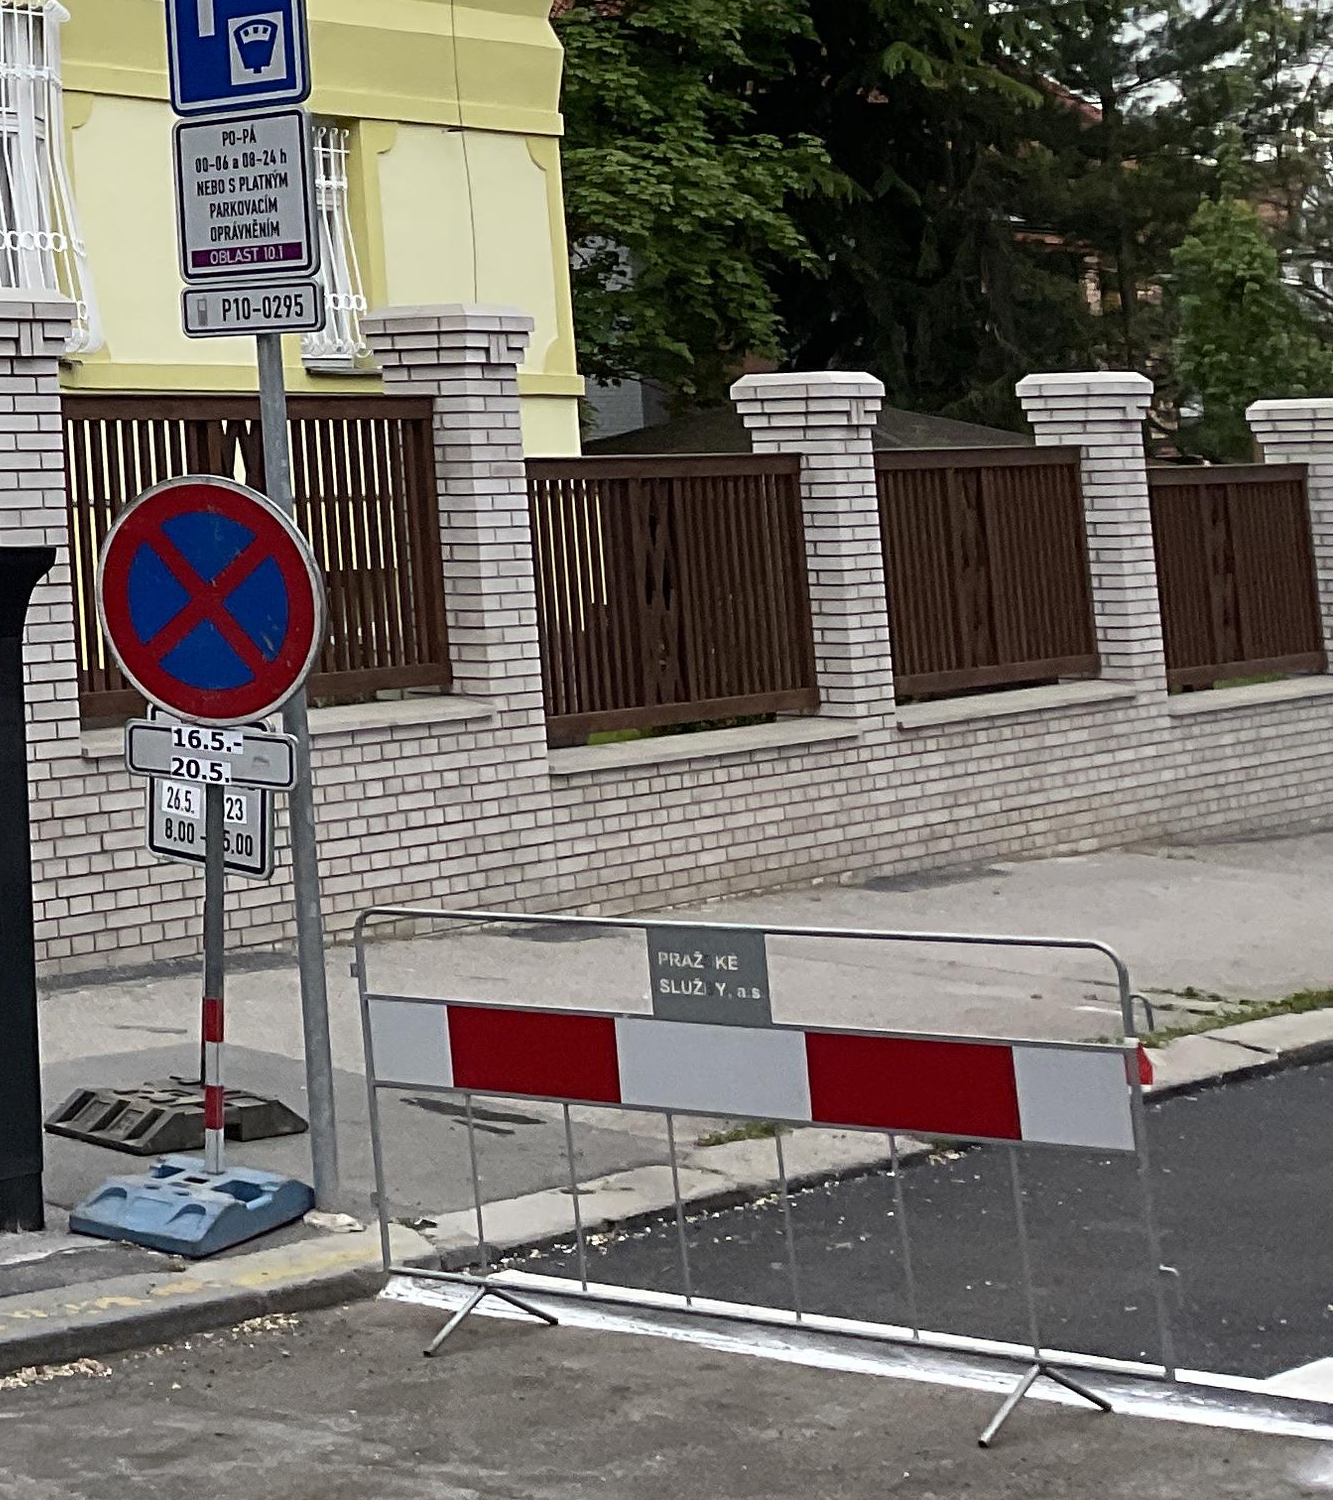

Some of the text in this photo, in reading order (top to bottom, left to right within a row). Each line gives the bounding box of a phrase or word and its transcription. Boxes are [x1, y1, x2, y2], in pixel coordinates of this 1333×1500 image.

[221, 124, 257, 147] PO-PÁ
[195, 148, 287, 173] 00-06 a 08-24 h
[196, 169, 288, 196] NEBO S PLATNÝM
[209, 194, 278, 219] PARKOVACÍM
[210, 218, 280, 242] OPRÁVNĚNÍM
[210, 245, 284, 265] OBLAST 10.1
[222, 294, 304, 322] P10-0295
[174, 728, 242, 752] 16.5.-
[172, 758, 230, 783] 20.5.
[167, 786, 195, 814] 26.5.
[223, 829, 253, 856] 5.00
[657, 951, 739, 971] PRAŽKÉ
